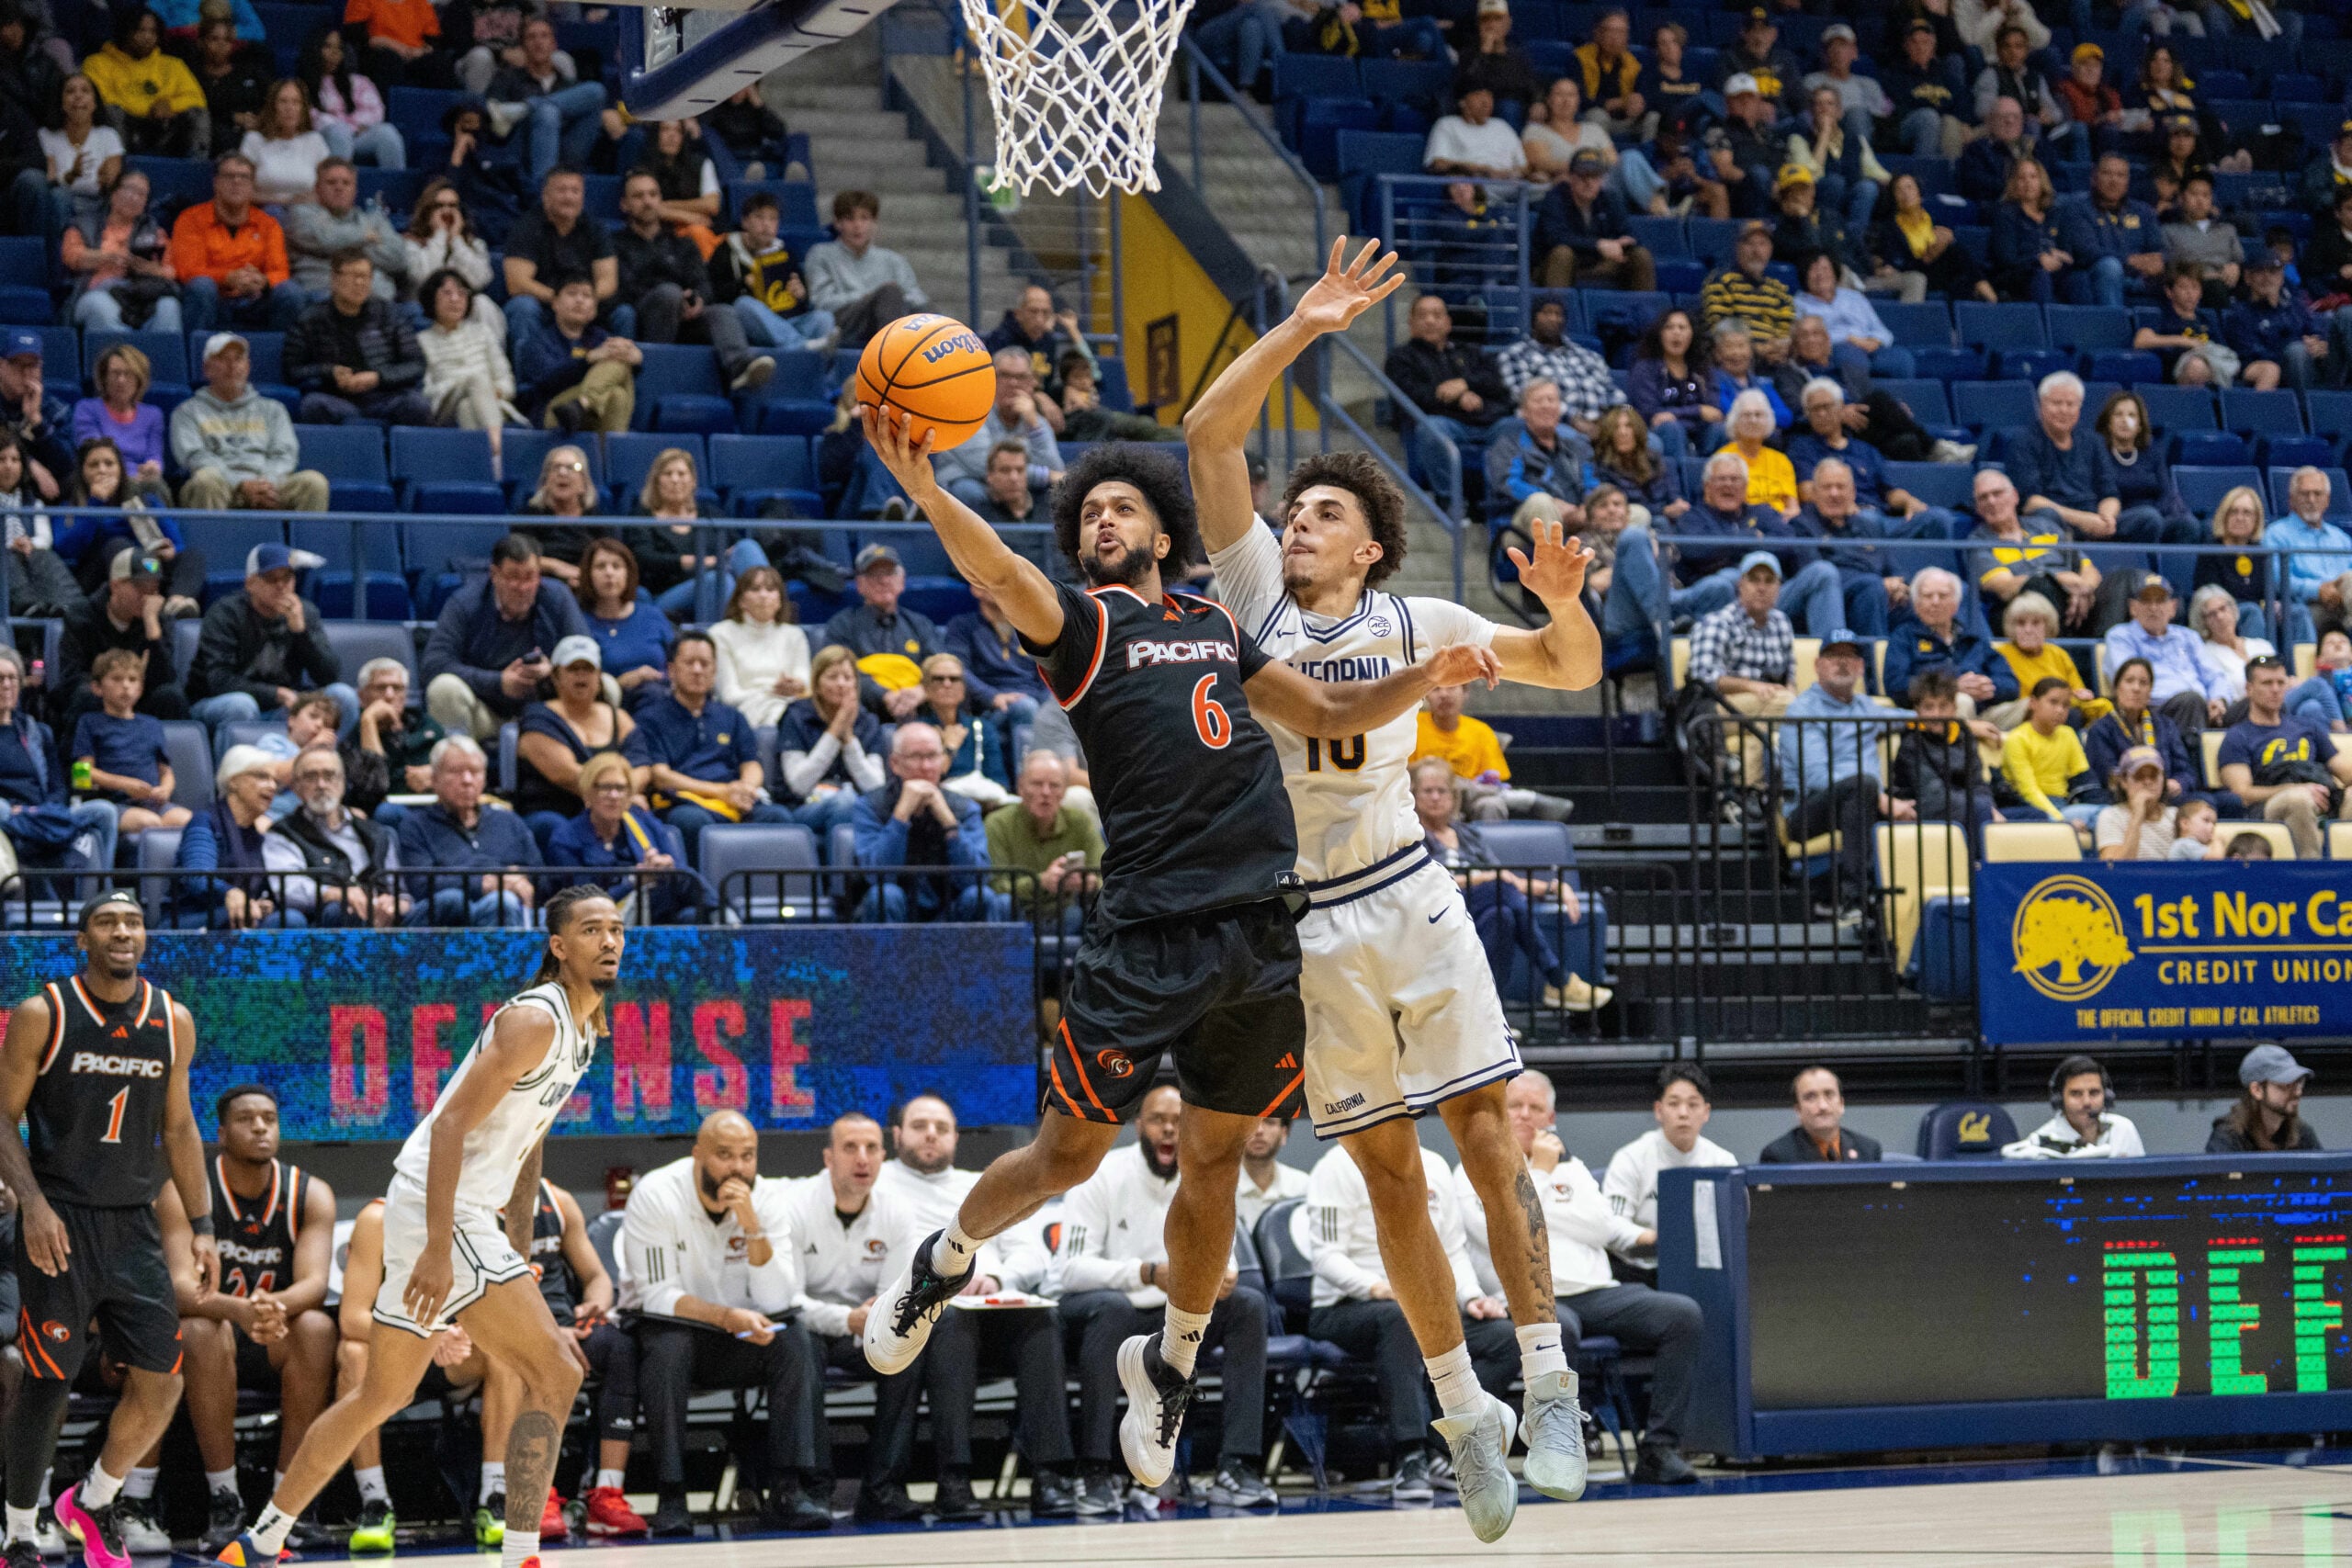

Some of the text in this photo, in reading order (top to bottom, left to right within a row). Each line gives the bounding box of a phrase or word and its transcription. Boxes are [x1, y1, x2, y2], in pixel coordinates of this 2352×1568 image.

[1126, 639, 1238, 670] PACIFIC
[1192, 672, 1232, 749] 6
[2134, 893, 2199, 938] 1st
[2213, 891, 2297, 937] Nor
[2157, 959, 2257, 984] CREDIT
[2075, 1006, 2320, 1029] THE OFFICIAL CREDIT UNION OF CAL ATHLETICS
[71, 1052, 164, 1077] PACIFIC
[330, 998, 814, 1120] DENSE
[99, 1084, 130, 1144] 1
[1326, 1092, 1365, 1114] CALIFORNIA
[1958, 1111, 1991, 1143] Cal
[218, 1239, 282, 1265] PACIFIC
[2103, 1241, 2347, 1399] DEF
